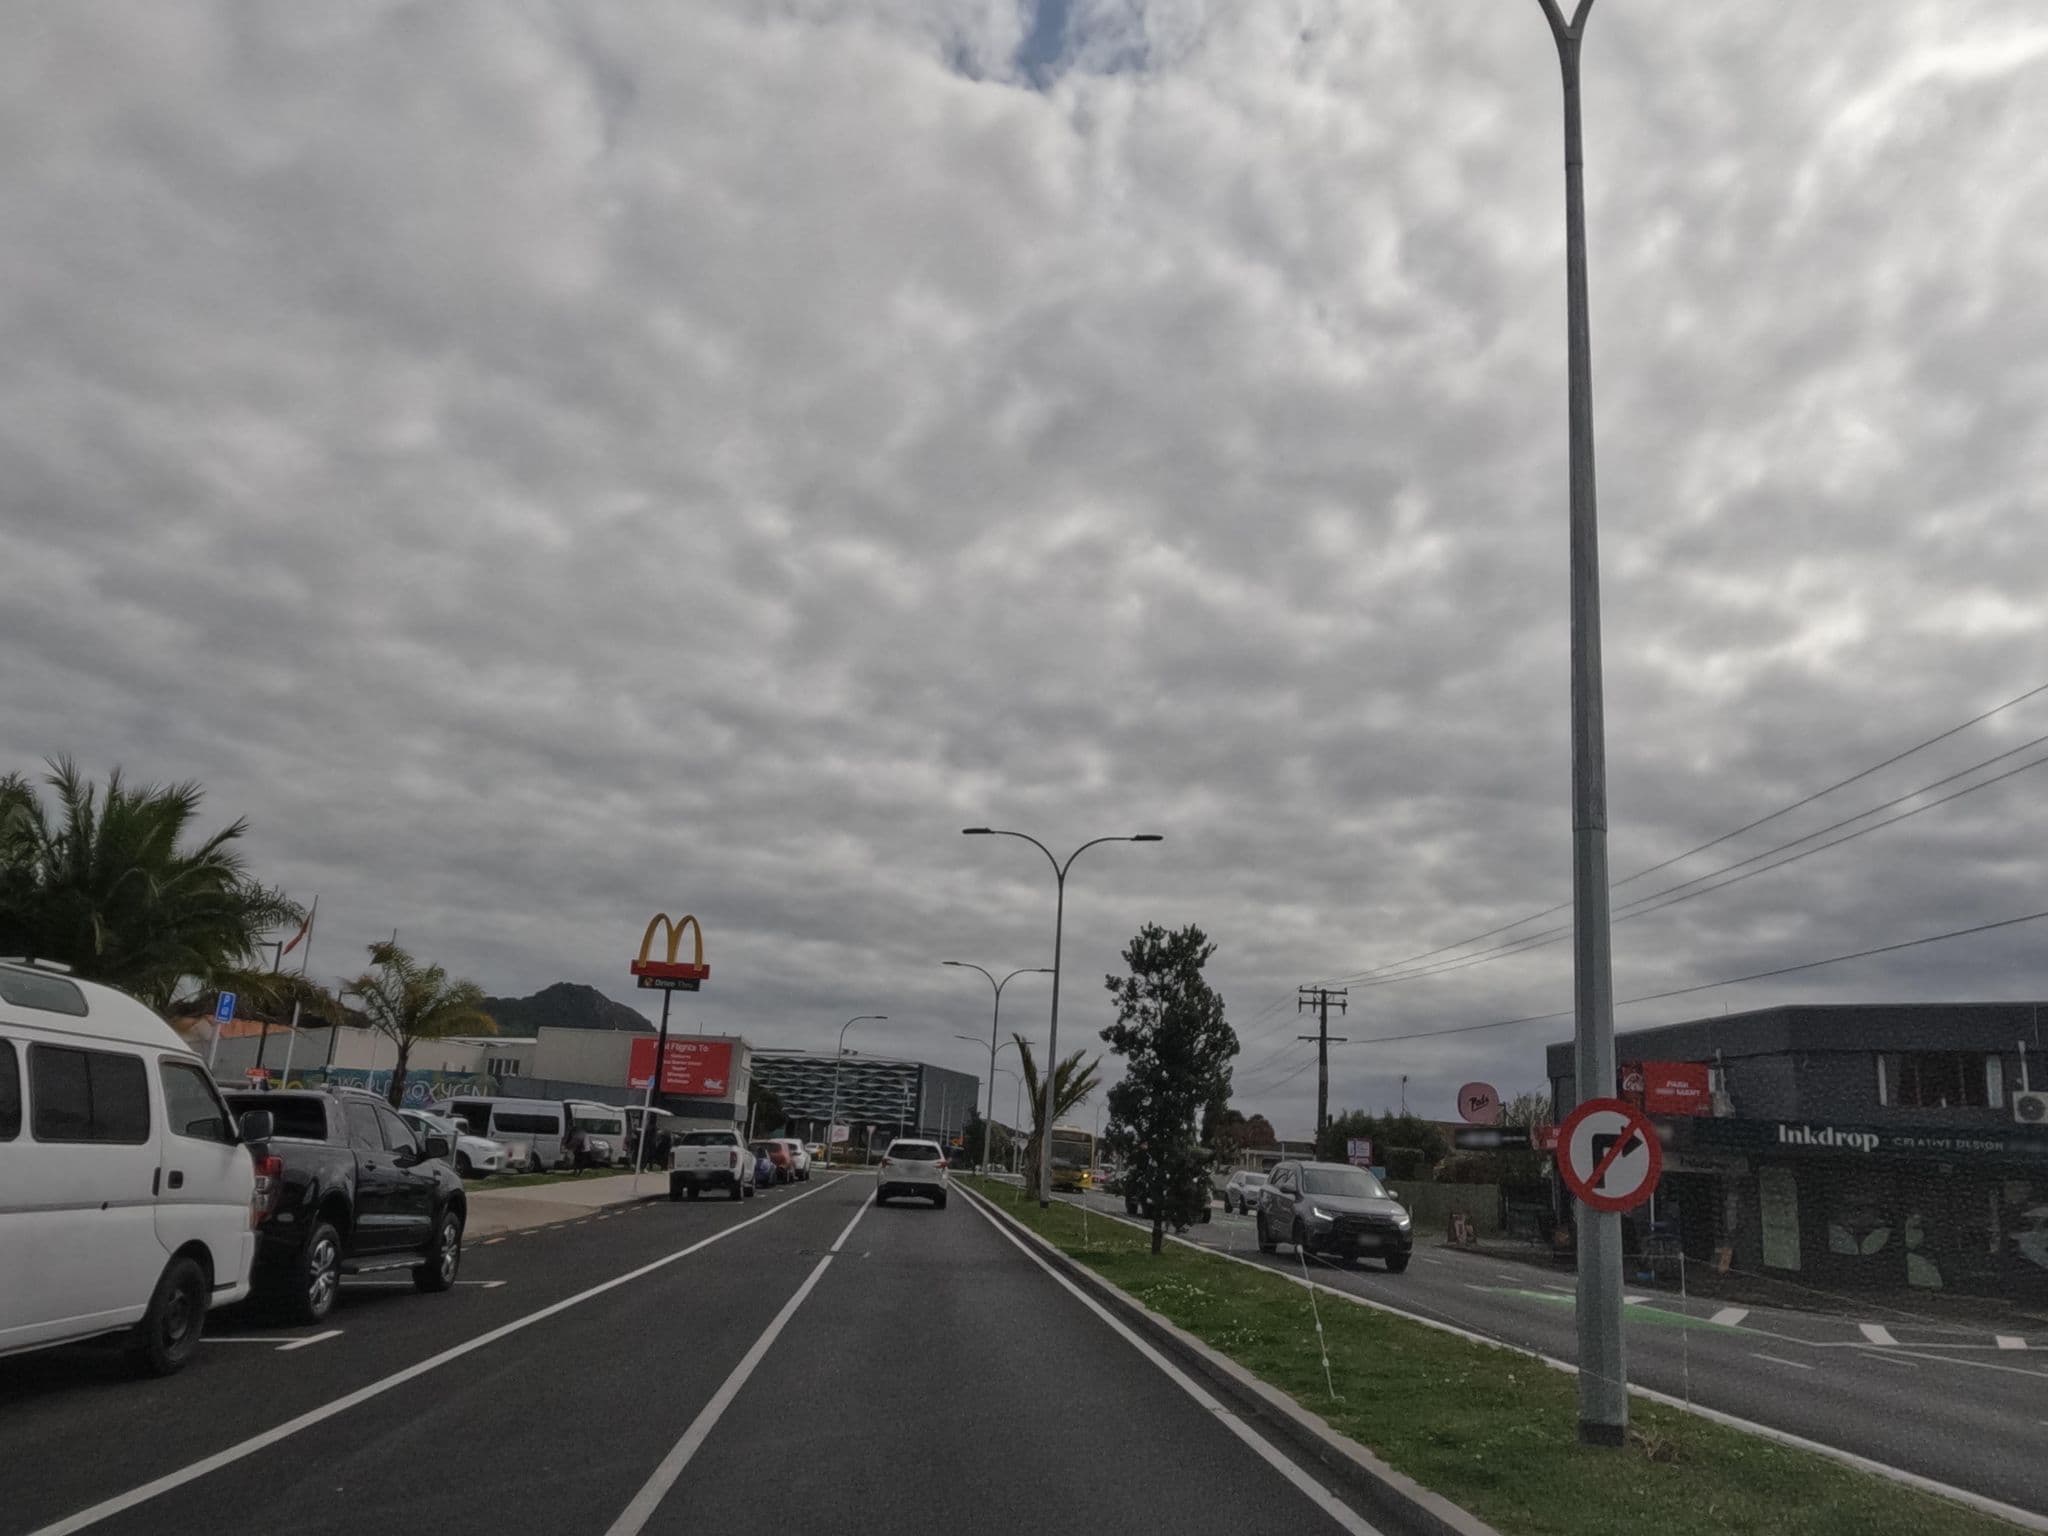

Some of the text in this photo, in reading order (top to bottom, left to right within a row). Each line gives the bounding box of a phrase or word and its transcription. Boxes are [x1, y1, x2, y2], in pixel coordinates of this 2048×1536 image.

[1778, 1124, 1880, 1152] Inkdrop
[1893, 1136, 1951, 1149] CREATIVE
[1956, 1138, 2004, 1152] DESIGN
